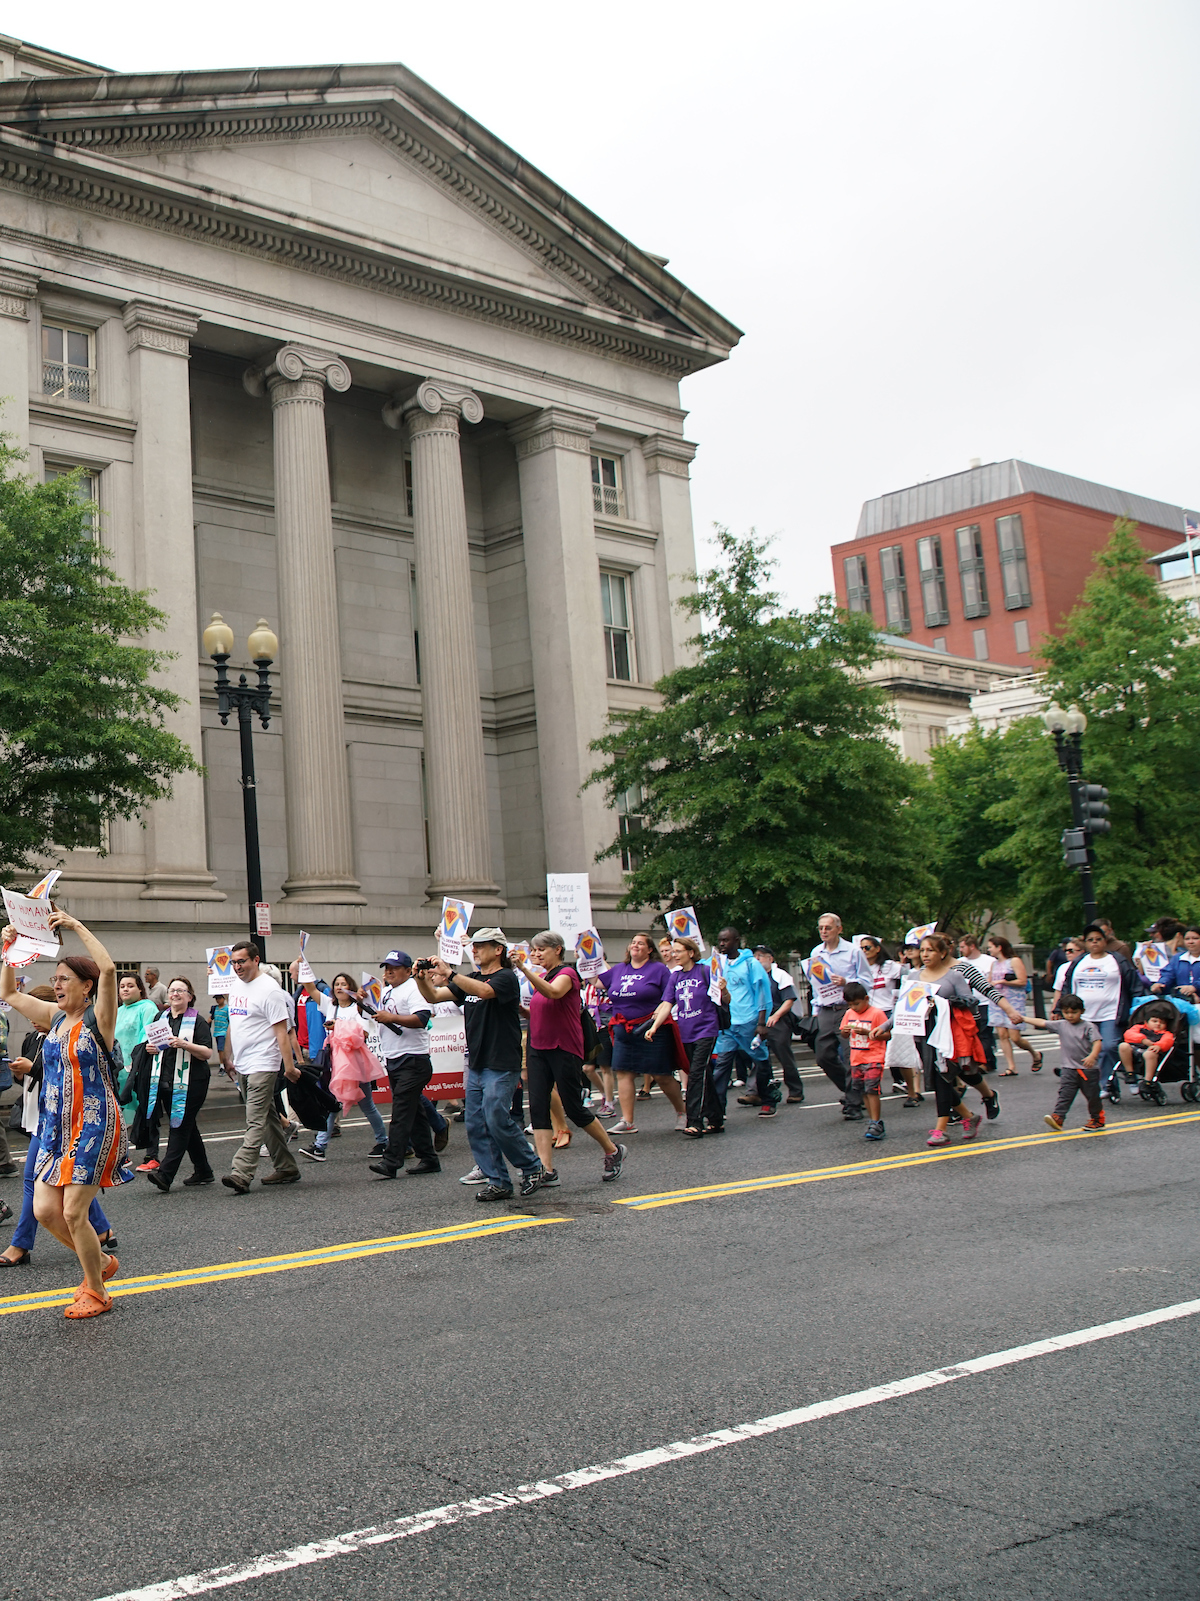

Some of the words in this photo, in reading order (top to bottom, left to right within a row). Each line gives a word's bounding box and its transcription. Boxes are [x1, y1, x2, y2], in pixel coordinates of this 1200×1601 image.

[19, 904, 49, 918] HUMAN
[675, 978, 702, 991] MERCY
[425, 1083, 441, 1092] Legal
